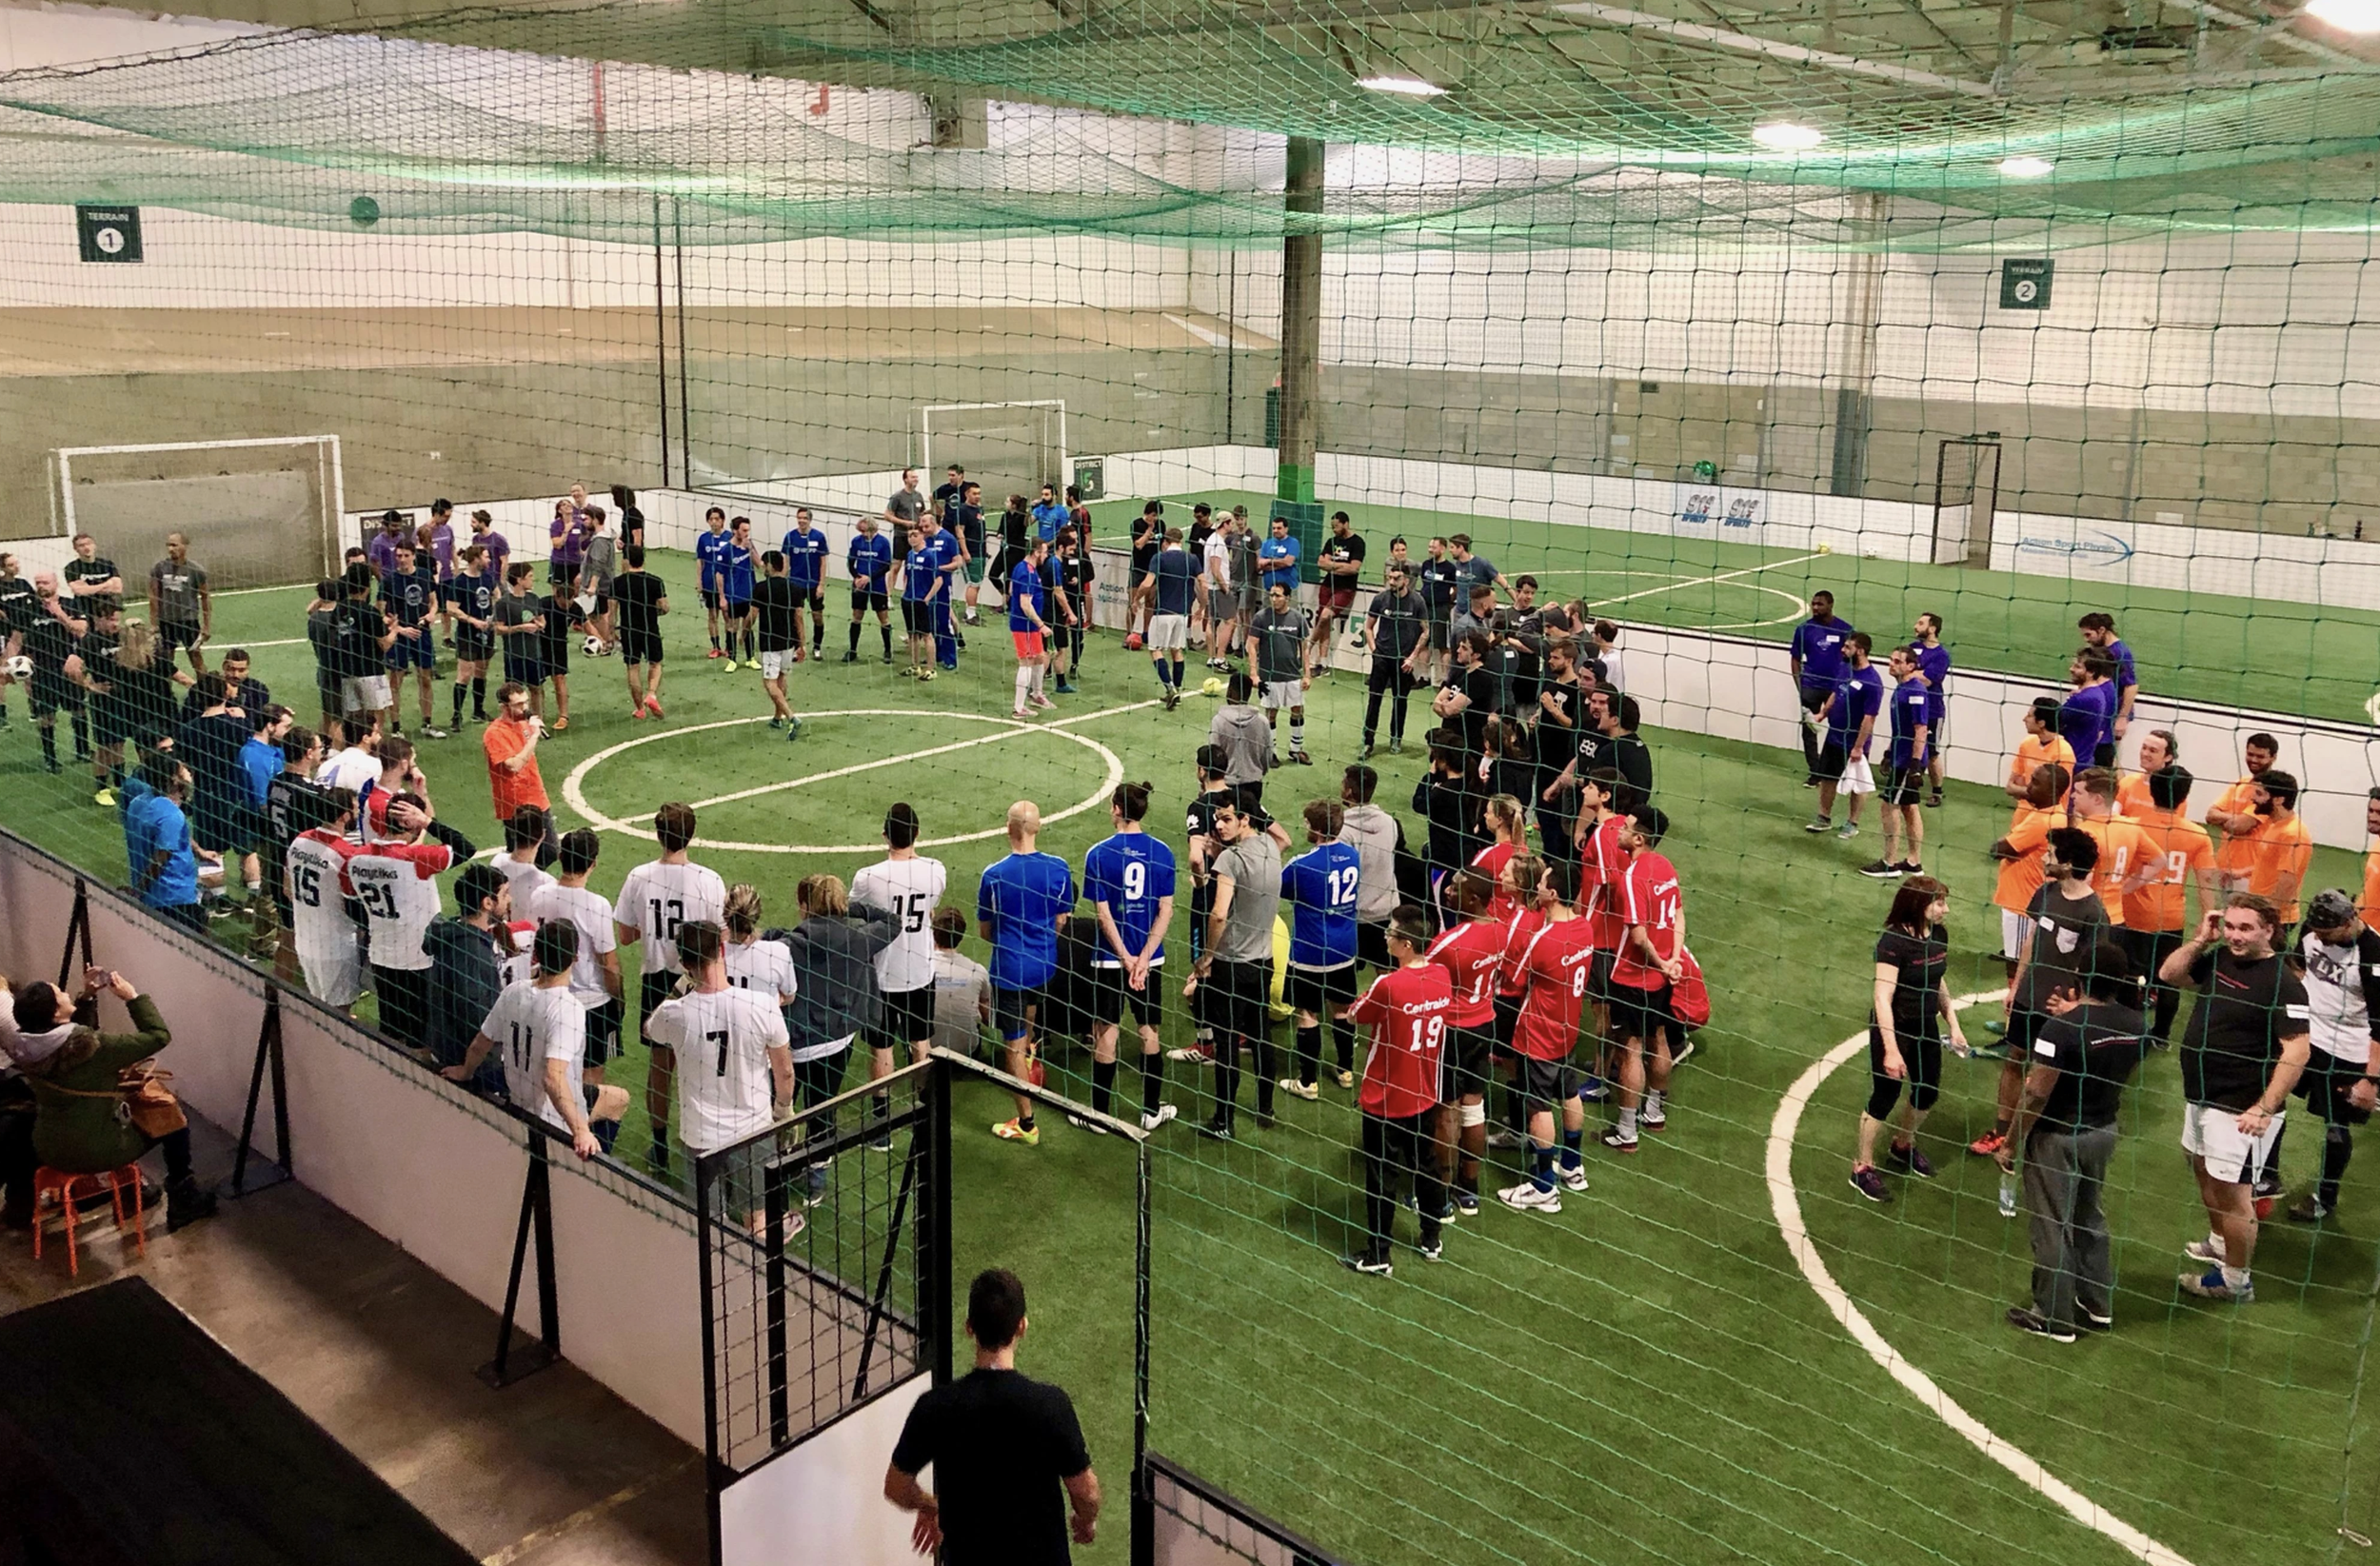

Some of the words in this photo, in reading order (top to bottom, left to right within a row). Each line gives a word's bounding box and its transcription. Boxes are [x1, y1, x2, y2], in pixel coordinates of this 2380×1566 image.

[88, 212, 129, 222] TERRAIN
[105, 232, 113, 248] 1
[2021, 284, 2031, 297] 2
[1083, 472, 1094, 492] 5
[1099, 582, 1125, 593] Action
[1350, 616, 1368, 648] 5
[291, 847, 328, 869] Playtika
[351, 865, 398, 880] Playtika
[293, 864, 321, 907] 15
[1124, 862, 1145, 901] 9
[1328, 865, 1359, 905] 12
[358, 882, 401, 919] 21
[1656, 894, 1676, 929] 14
[649, 899, 684, 940] 12
[1573, 964, 1586, 998] 8
[510, 1021, 532, 1073] 11
[1409, 1015, 1444, 1052] 19
[706, 1030, 728, 1077] 7
